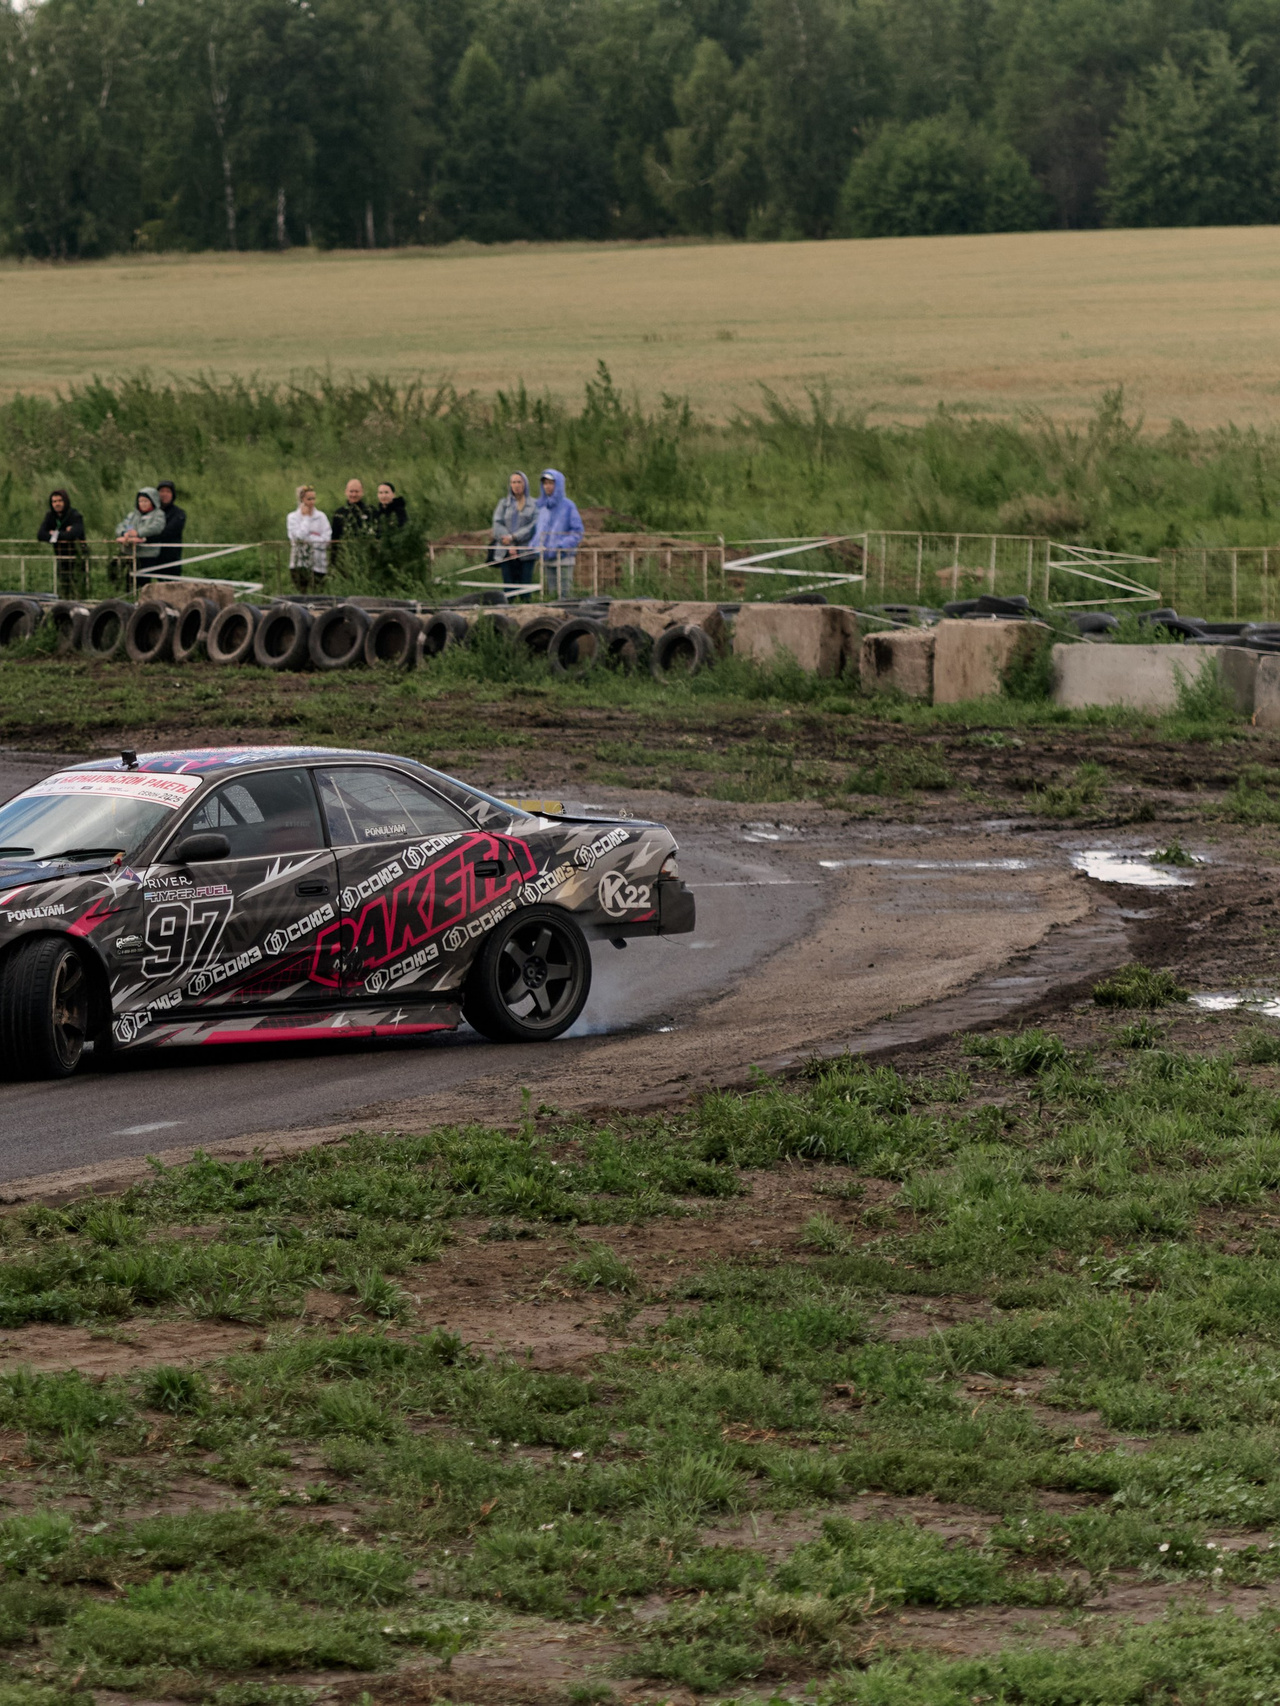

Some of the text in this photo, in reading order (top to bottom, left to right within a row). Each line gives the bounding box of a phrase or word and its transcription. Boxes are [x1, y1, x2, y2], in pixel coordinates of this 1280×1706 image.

[142, 778, 195, 795] РАКЕТЫ
[365, 824, 406, 837] PONULYAM
[147, 876, 193, 889] RIVER
[357, 861, 404, 899] СОЮЗ
[7, 904, 65, 922] PONULYAM
[287, 902, 335, 943] СОЮЗ
[141, 896, 234, 979] 97
[212, 945, 263, 983] СОЮЗ
[389, 943, 439, 981] СОЮЗ
